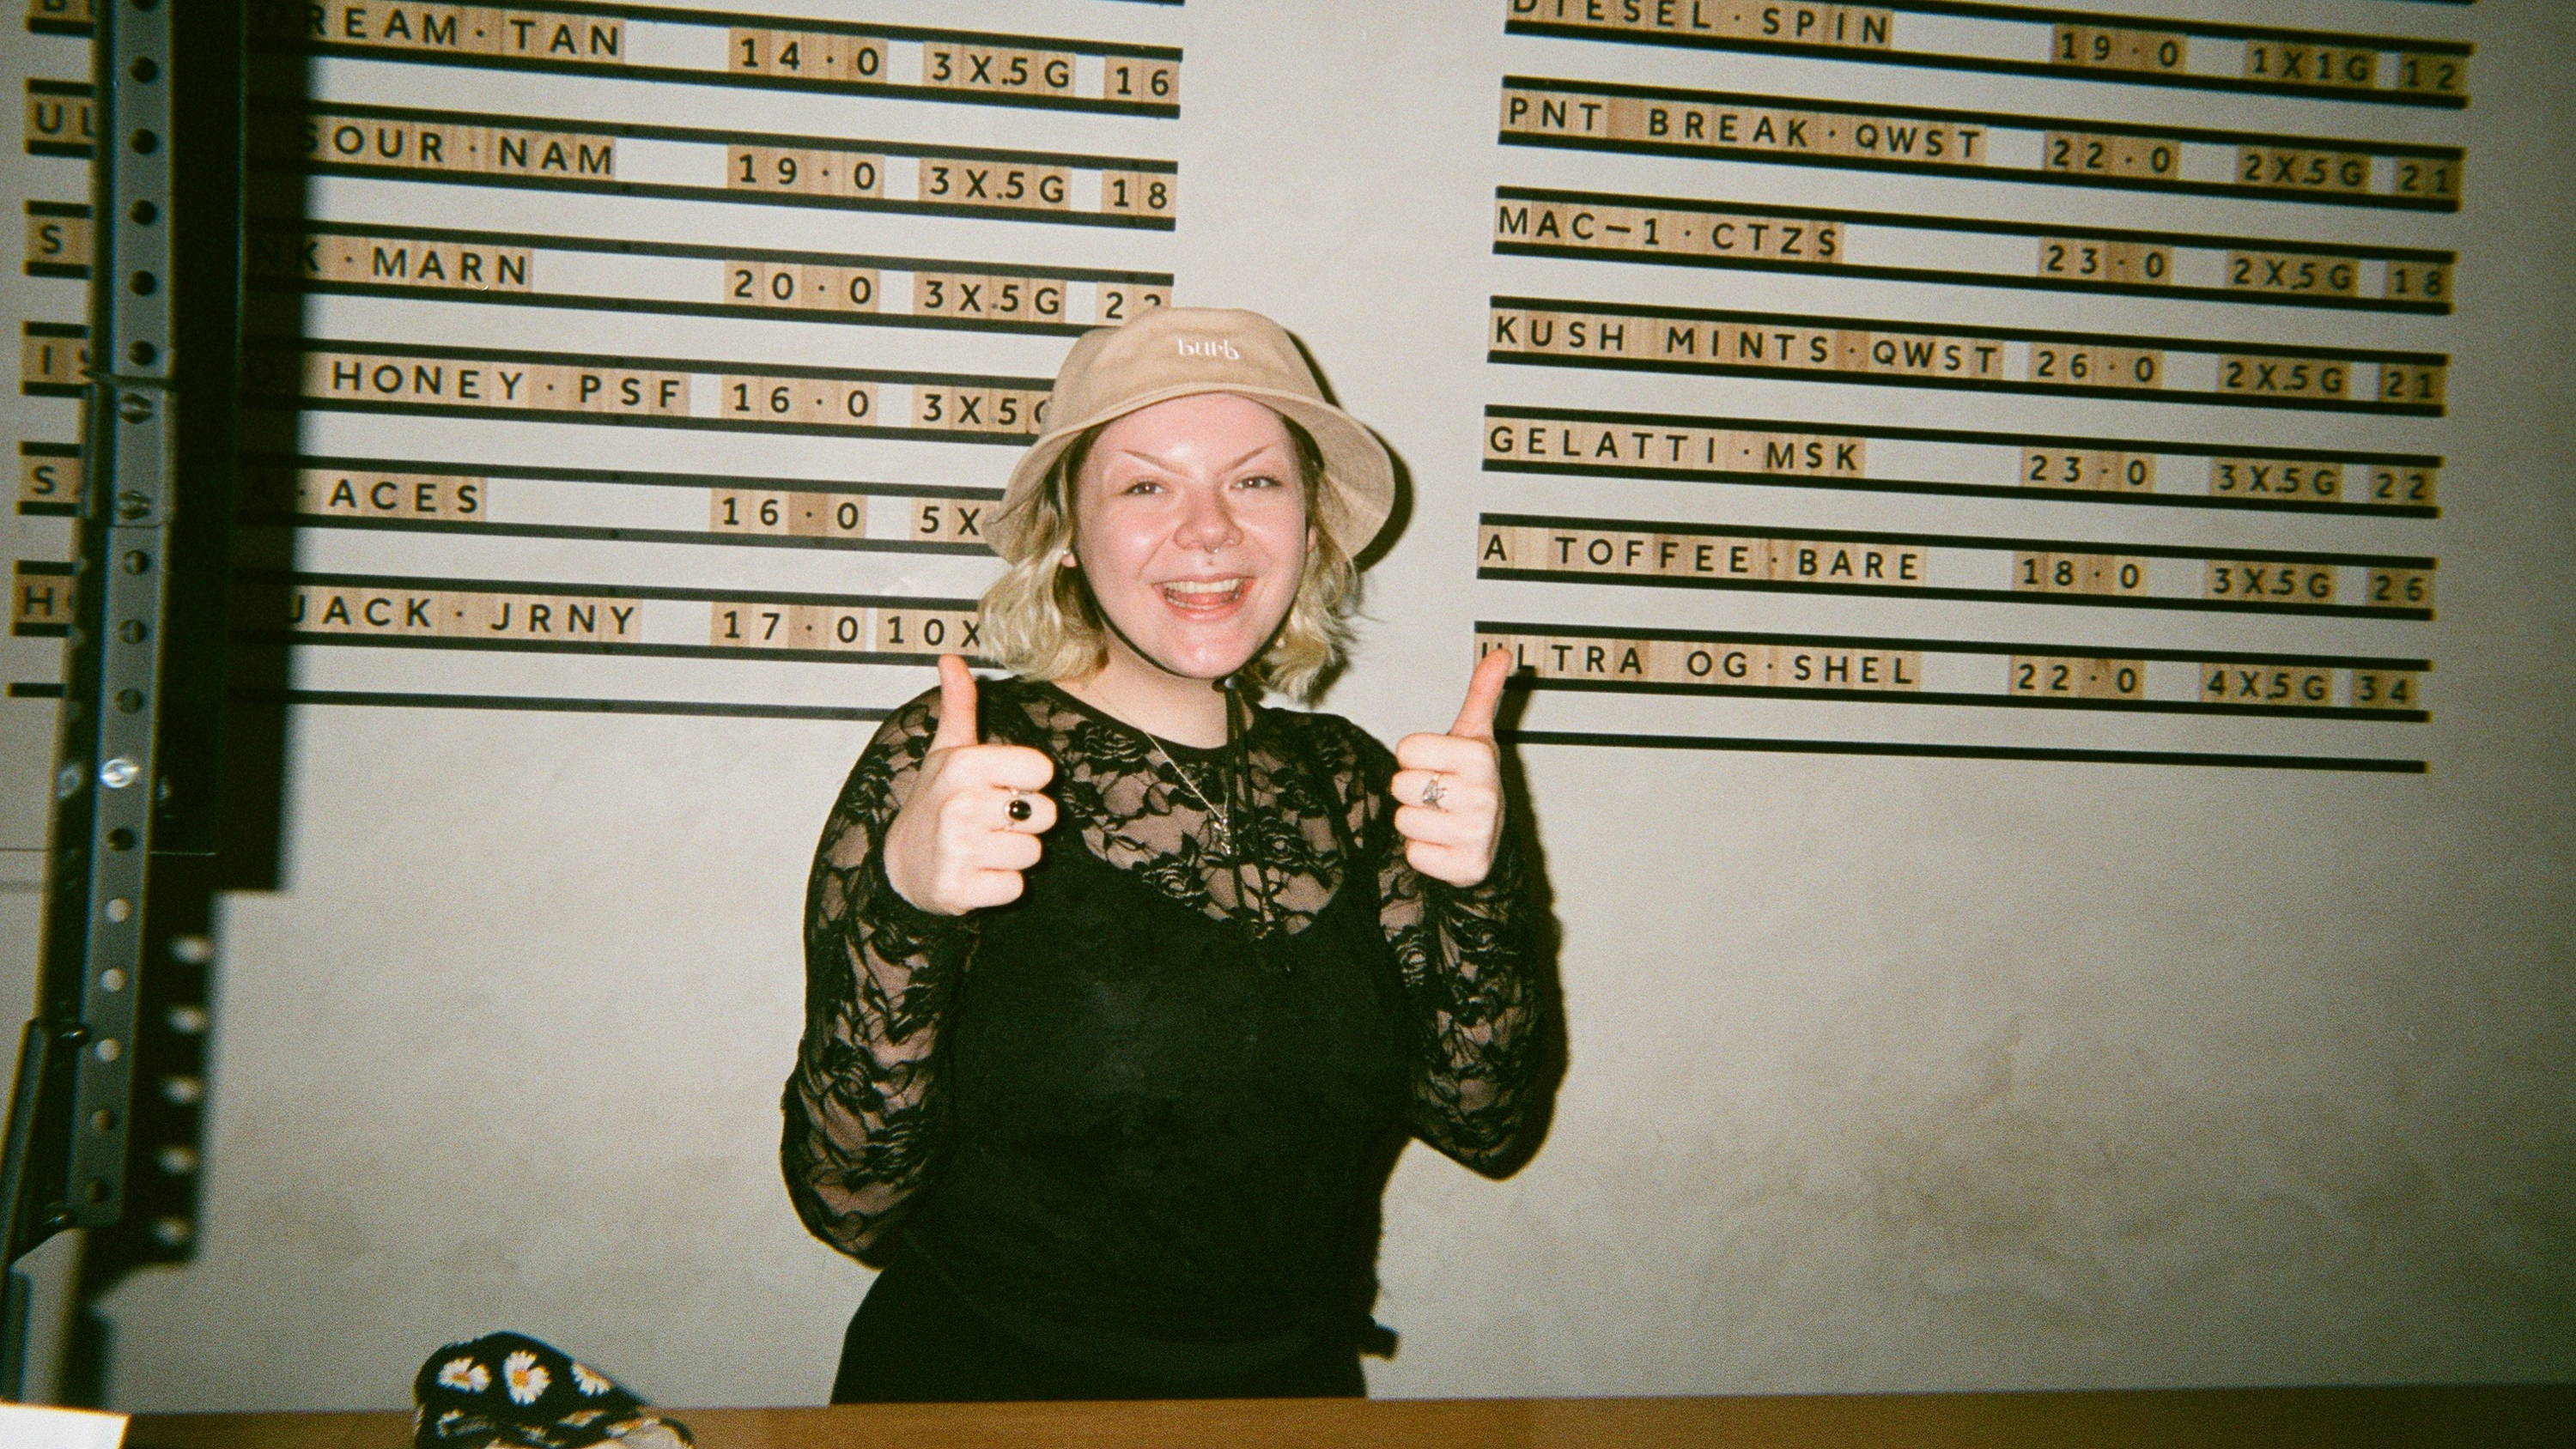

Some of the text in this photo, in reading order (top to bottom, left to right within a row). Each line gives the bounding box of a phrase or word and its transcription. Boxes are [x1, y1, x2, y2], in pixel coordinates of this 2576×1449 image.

[1116, 68, 1170, 97] 16
[2251, 46, 2370, 82] 1X1G
[2406, 60, 2458, 89] 12
[1508, 96, 1603, 131] PNT
[2395, 163, 2451, 194] 21
[1112, 179, 1169, 209] 18
[2391, 268, 2444, 298] 18
[1176, 336, 1240, 360] burb
[1495, 315, 1625, 351] KUSH
[2379, 370, 2436, 401] 21
[2374, 472, 2429, 502] 22
[1482, 533, 1508, 562] A
[2372, 573, 2425, 603] 26
[2357, 674, 2411, 705] 34
